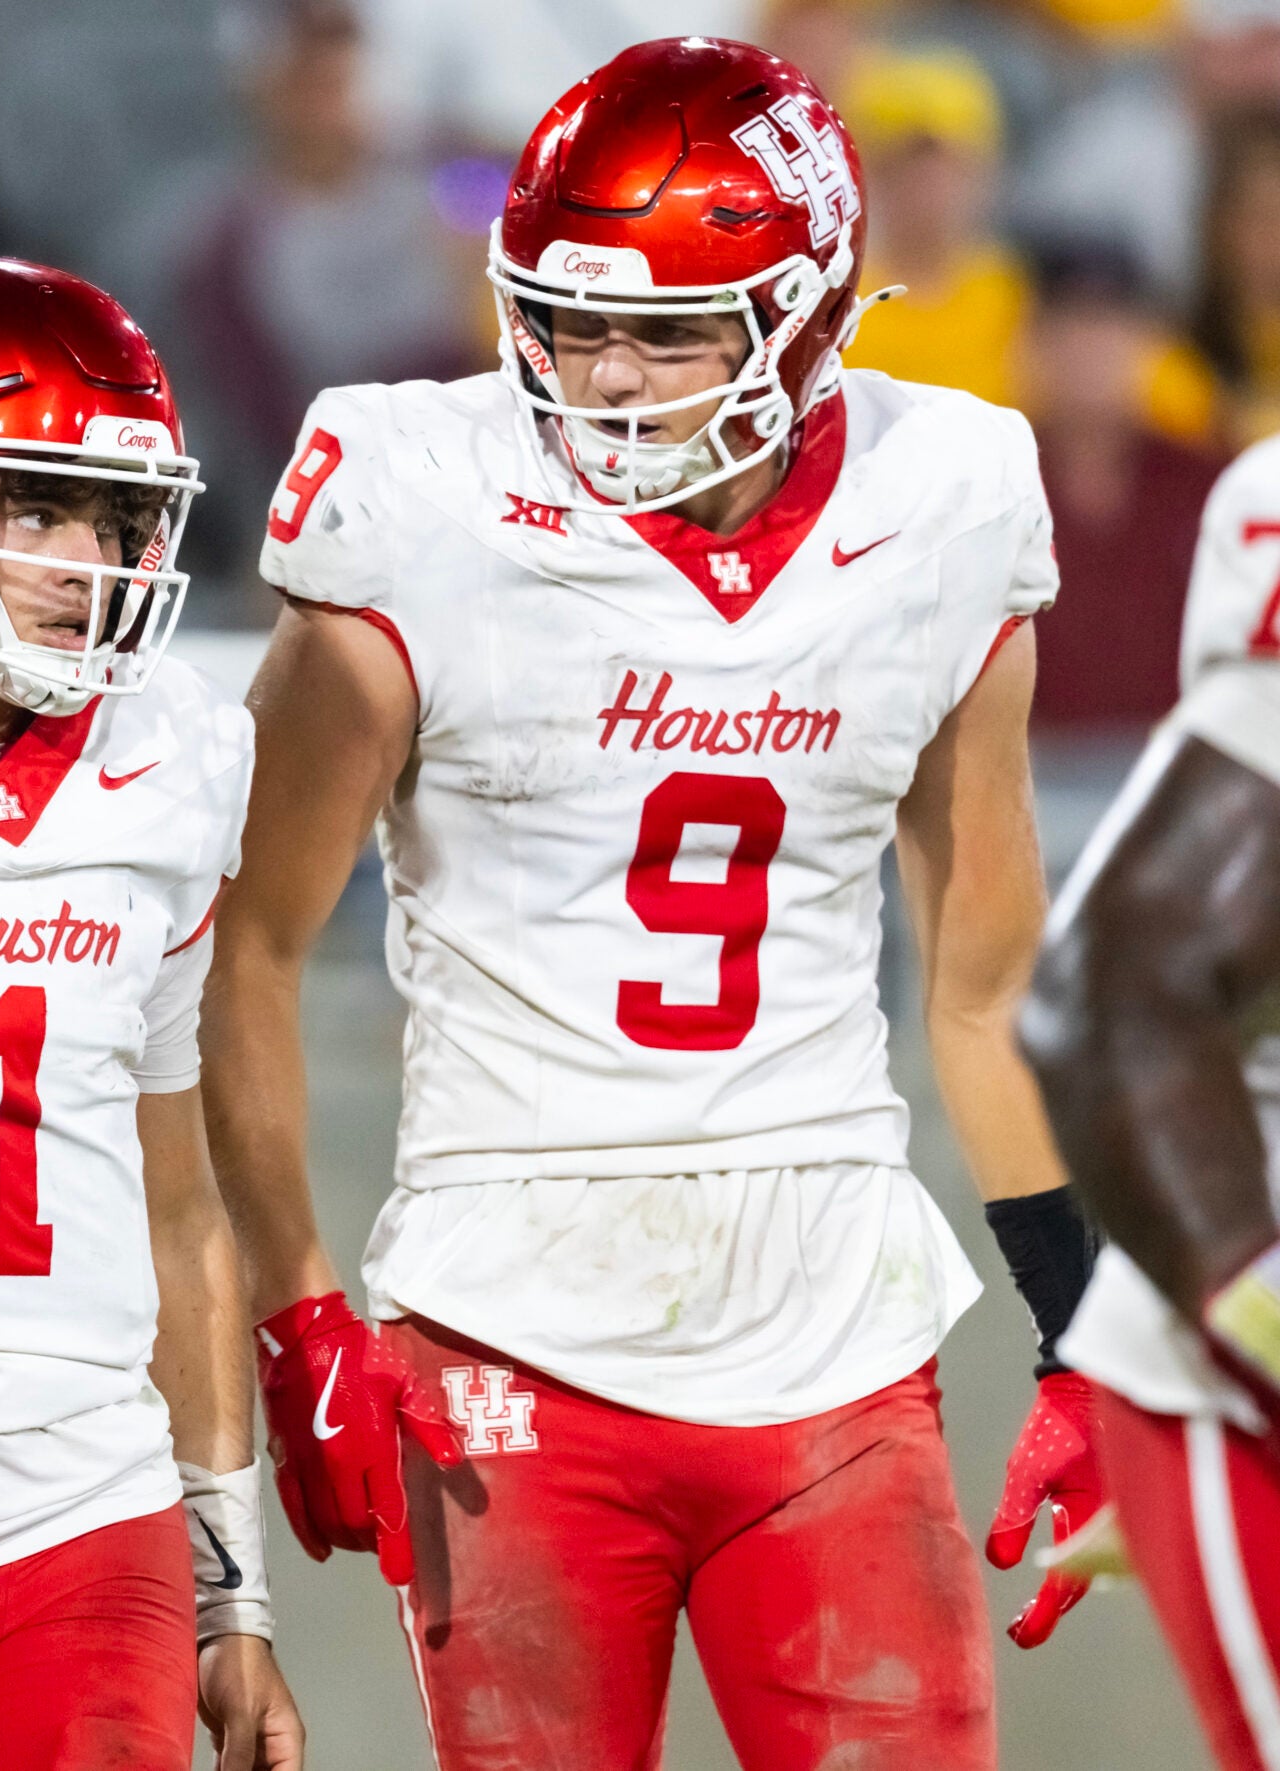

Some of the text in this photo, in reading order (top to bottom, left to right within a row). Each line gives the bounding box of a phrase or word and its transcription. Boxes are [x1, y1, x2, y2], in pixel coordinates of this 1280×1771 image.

[563, 251, 611, 281] Coogs
[117, 425, 158, 452] Coogs
[267, 423, 344, 544] 9
[502, 492, 568, 537] XII
[597, 669, 841, 756] Houston
[615, 771, 788, 1052] 9
